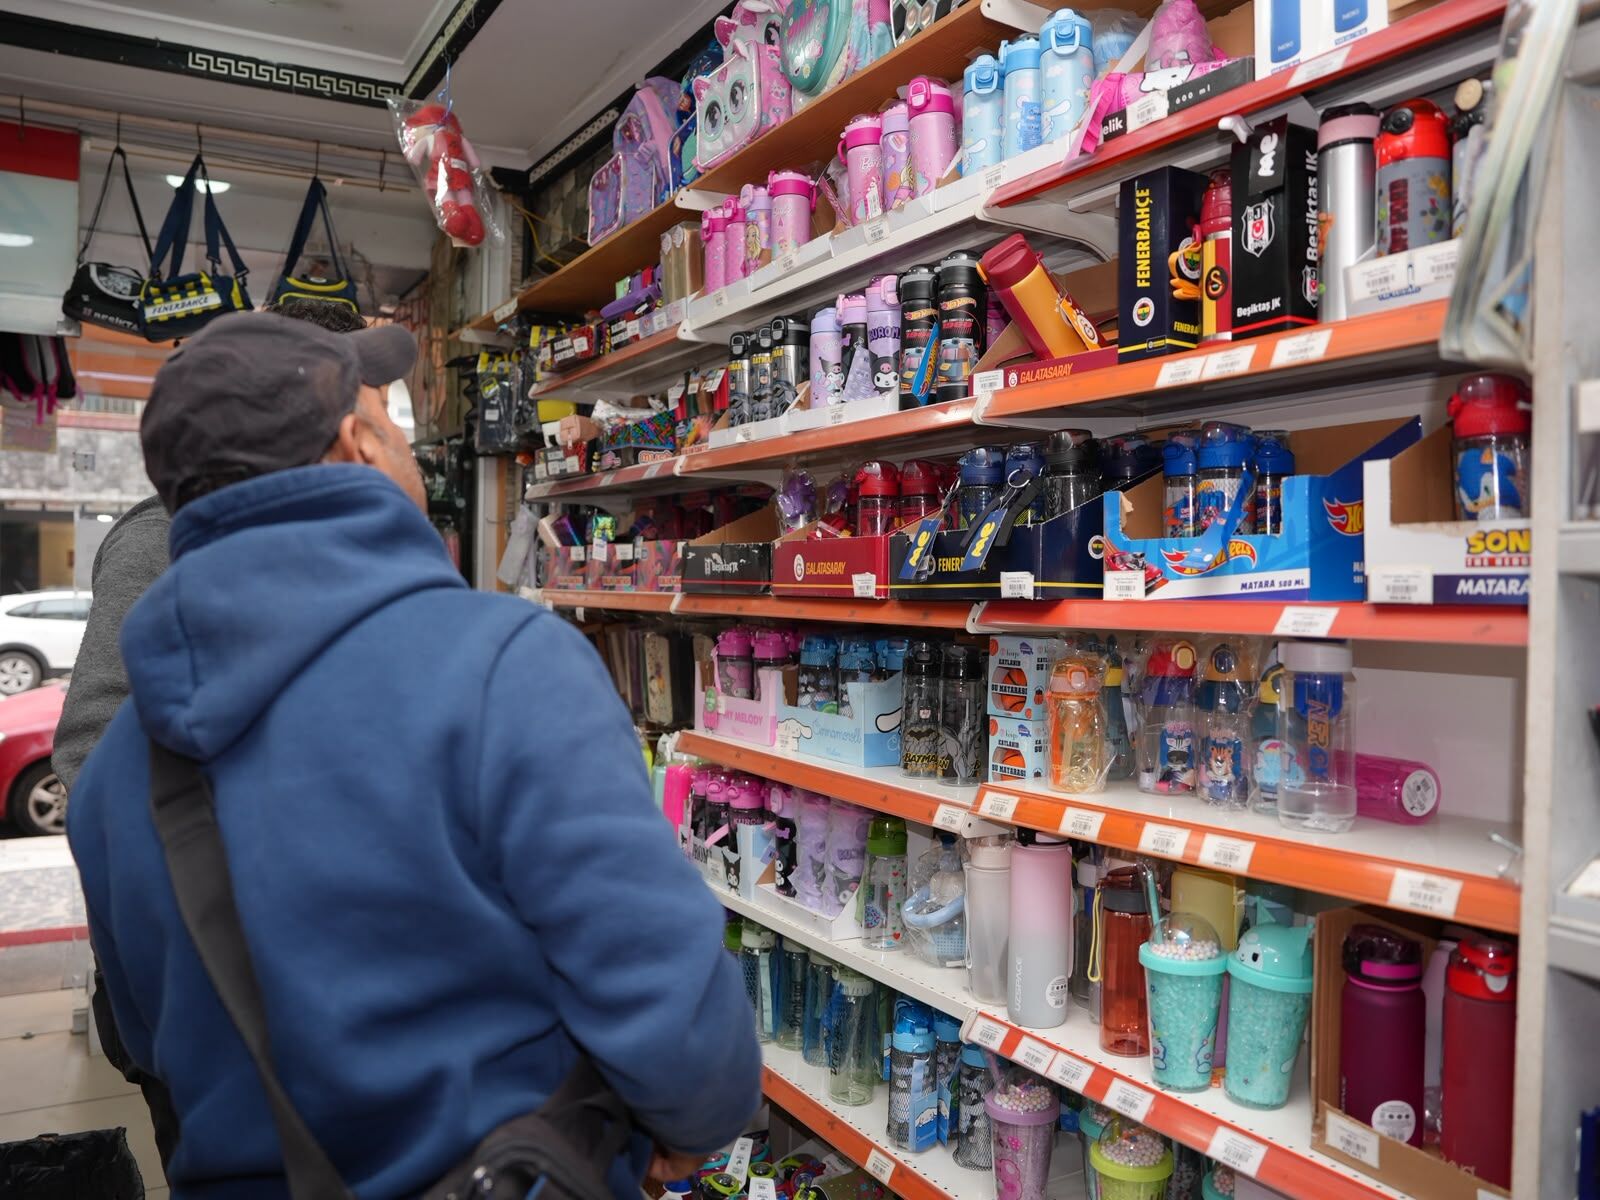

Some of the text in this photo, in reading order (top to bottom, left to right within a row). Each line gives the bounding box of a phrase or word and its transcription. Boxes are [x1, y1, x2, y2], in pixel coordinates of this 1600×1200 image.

[1102, 117, 1124, 135] elik
[1135, 187, 1153, 288] FENERBAHÇE
[1271, 296, 1281, 311] JK
[1173, 320, 1200, 335] FENERBA
[1020, 363, 1074, 384] GALATASARAY
[1466, 528, 1531, 555] SON
[805, 561, 847, 576] GALATASARAY
[1240, 580, 1275, 590] MATARA
[1456, 578, 1530, 596] MATARA
